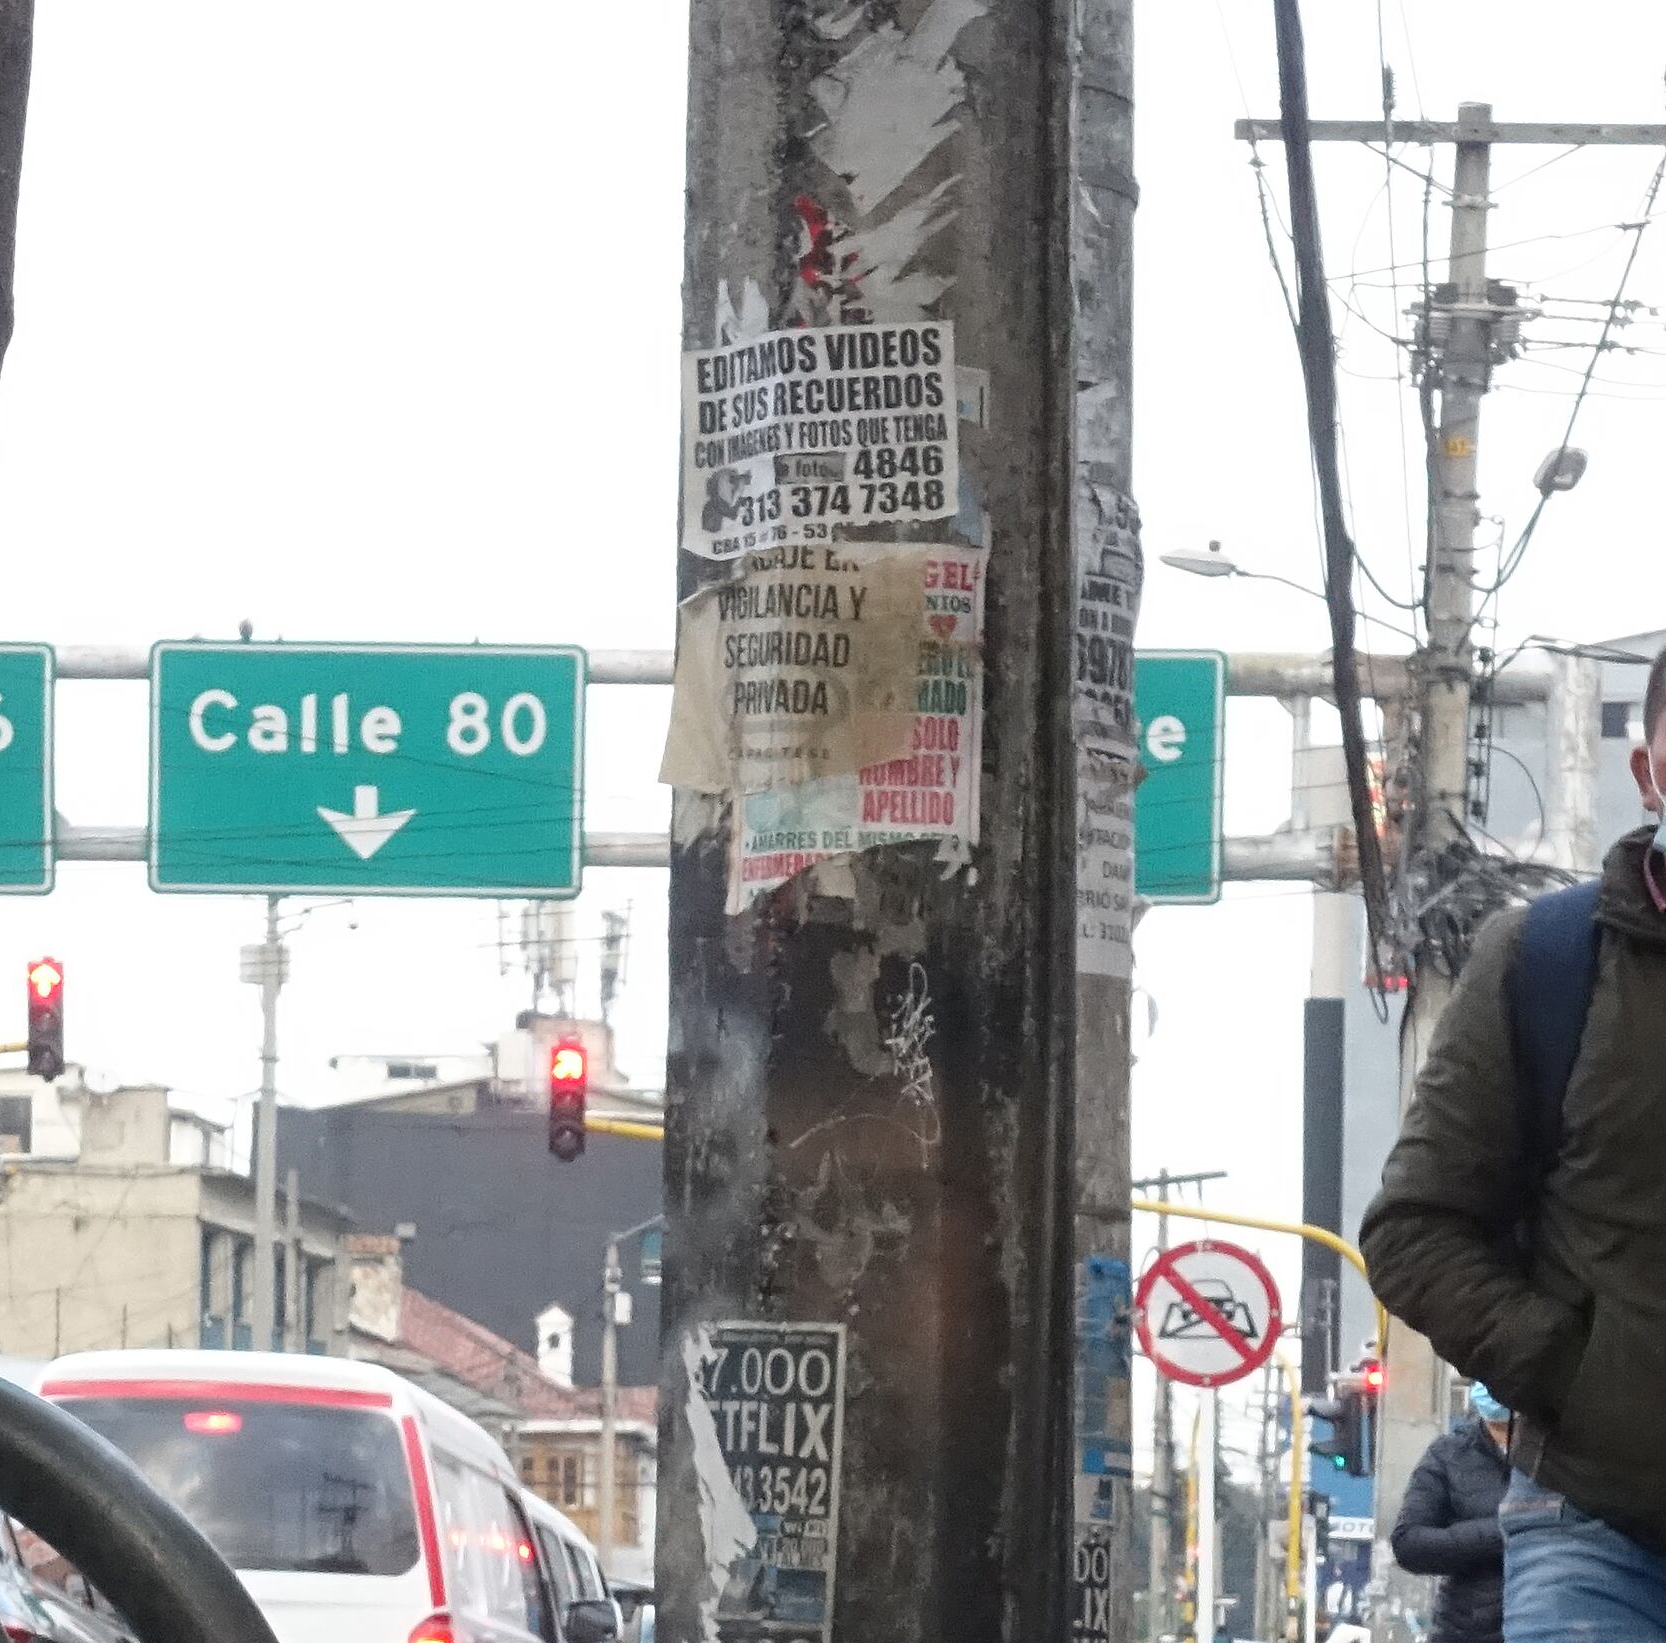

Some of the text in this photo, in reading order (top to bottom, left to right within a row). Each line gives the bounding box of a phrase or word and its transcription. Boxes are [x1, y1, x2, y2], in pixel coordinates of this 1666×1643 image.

[697, 328, 941, 393] EDITAMOS VIDEOS
[698, 372, 944, 436] DE SUS RECUERDOS
[694, 436, 725, 469] CON
[783, 422, 794, 450] Y
[798, 418, 853, 449] FOTOS
[856, 416, 888, 449] QUE
[892, 412, 948, 443] TENGA
[853, 445, 944, 479] 4846
[737, 478, 945, 527] 313 374 7348
[803, 522, 827, 540] 53
[717, 582, 868, 622] VIGILANCIA Y
[724, 631, 850, 669] SEGURIDAD
[733, 678, 829, 716] PRIVADA
[188, 688, 547, 757] Calle 80
[862, 790, 955, 826] APELLIDO
[708, 1398, 831, 1462] TFLIX
